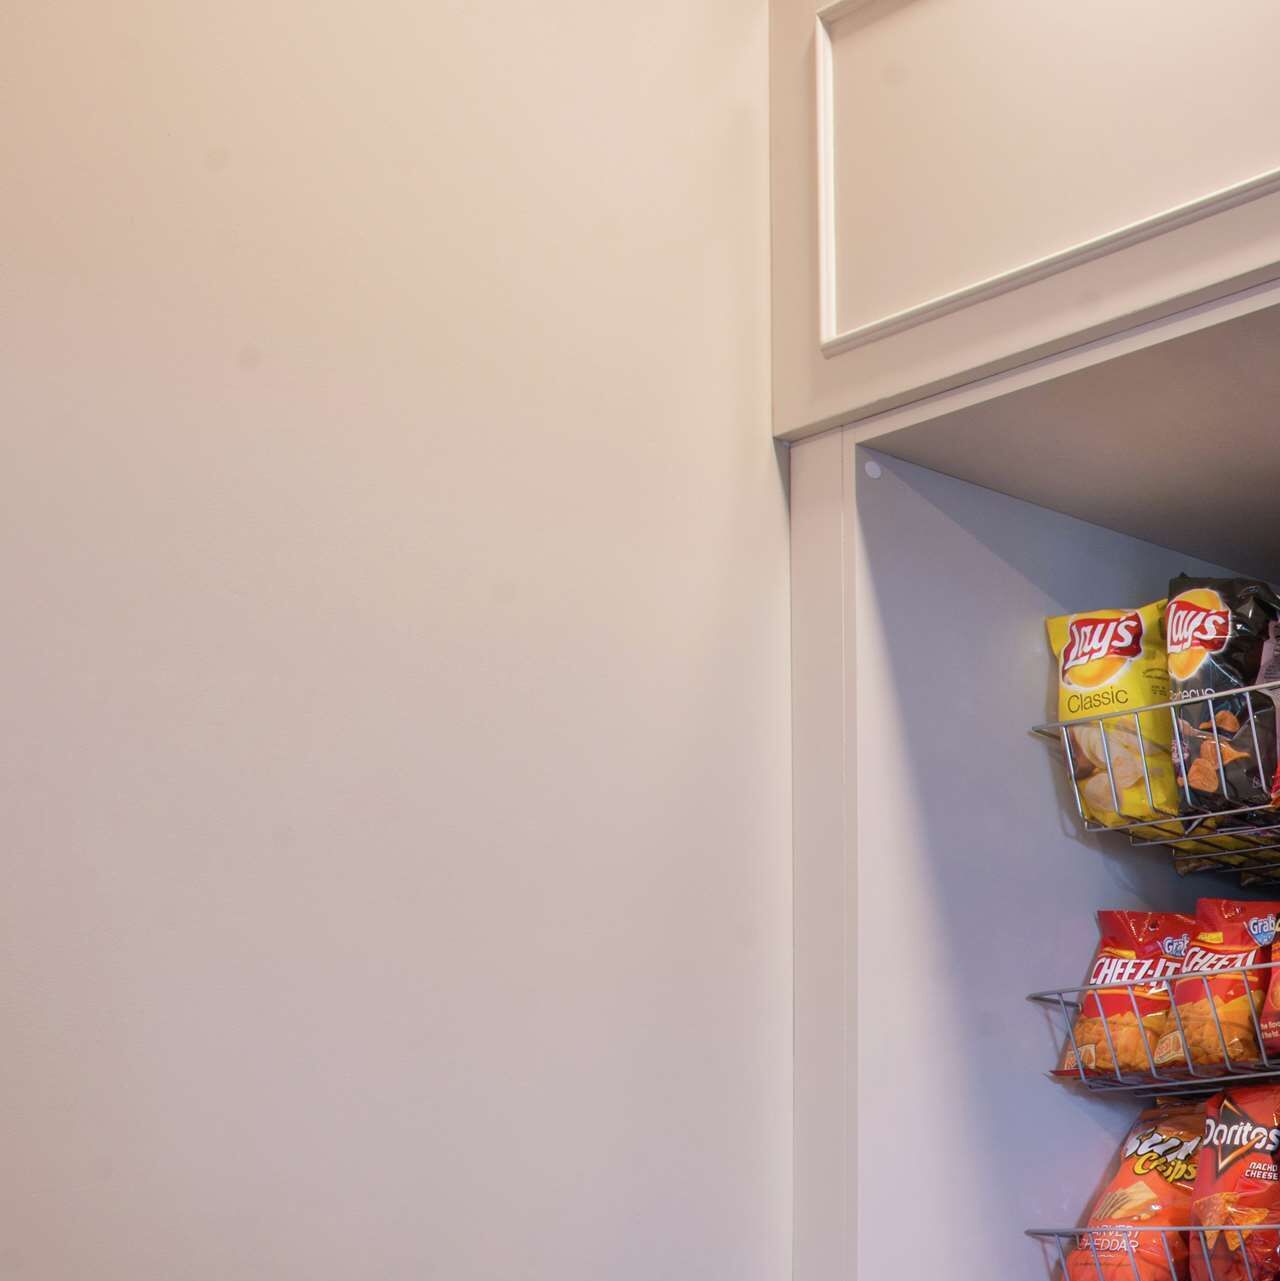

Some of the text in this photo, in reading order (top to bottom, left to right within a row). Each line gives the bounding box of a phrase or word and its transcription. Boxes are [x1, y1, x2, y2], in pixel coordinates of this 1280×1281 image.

[1167, 601, 1225, 653] Lay's
[1065, 616, 1139, 669] Lay's
[1067, 686, 1129, 714] Classic
[1250, 916, 1275, 933] Grab
[1244, 1169, 1279, 1181] CHEESE
[1249, 1161, 1279, 1172] NACHO
